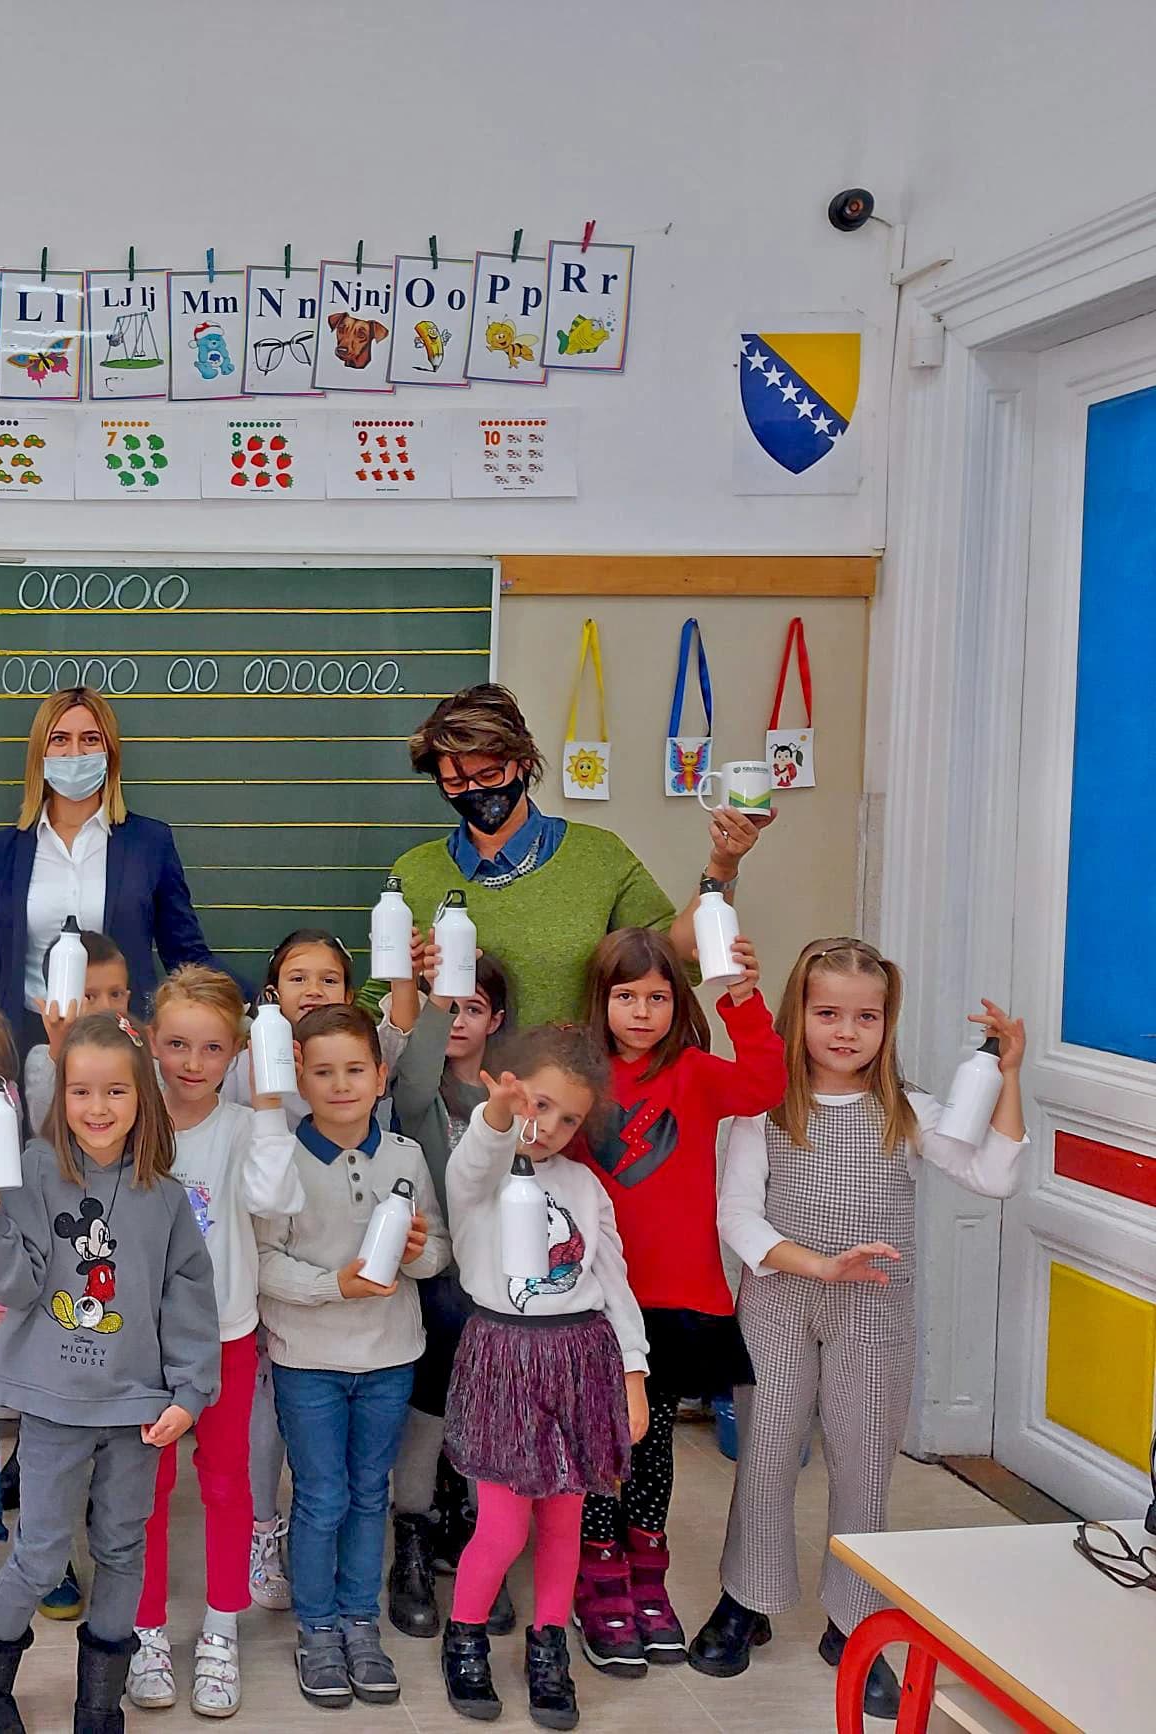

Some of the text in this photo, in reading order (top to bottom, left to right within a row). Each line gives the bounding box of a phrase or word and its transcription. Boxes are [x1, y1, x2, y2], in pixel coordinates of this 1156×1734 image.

[330, 280, 391, 315] Njnj
[107, 431, 118, 447] 7
[232, 432, 242, 447] 8
[358, 430, 368, 446] 9
[484, 430, 501, 446] 10
[62, 1344, 106, 1356] MICKEY
[60, 1354, 105, 1367] MOUSE
